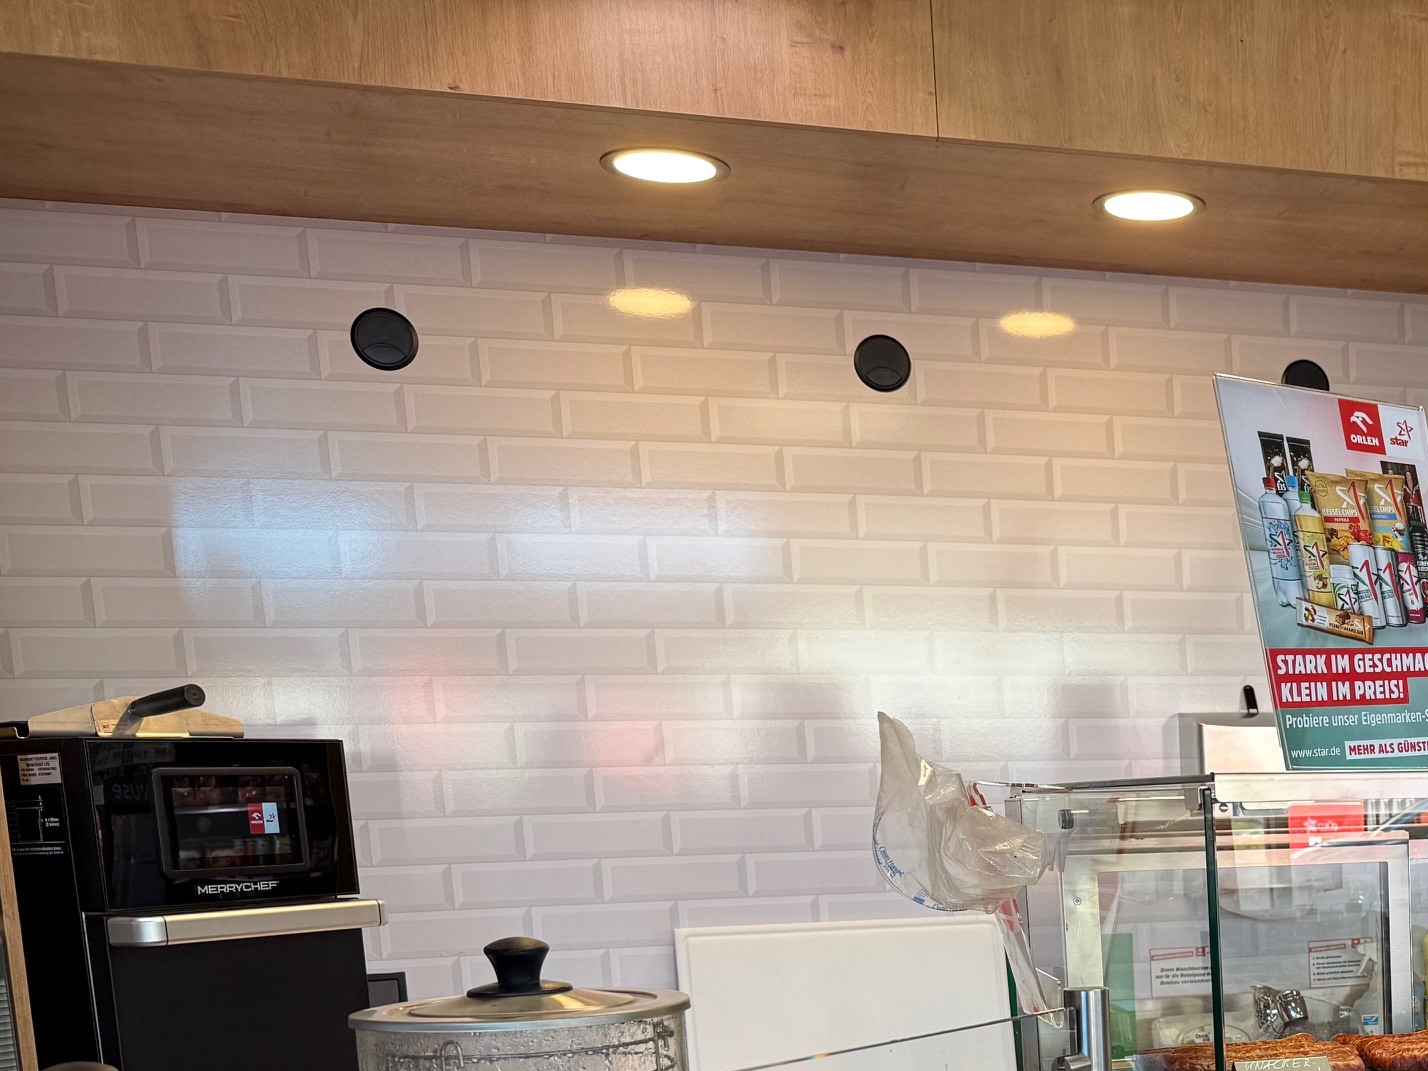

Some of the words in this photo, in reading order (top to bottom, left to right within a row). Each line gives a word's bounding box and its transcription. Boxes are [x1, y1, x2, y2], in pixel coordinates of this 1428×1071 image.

[1350, 434, 1379, 447] ORLEN
[1390, 437, 1409, 447] star
[1277, 654, 1326, 674] STARK
[1331, 654, 1349, 674] IM
[1281, 681, 1328, 702] KLEIN
[1332, 681, 1350, 700] IM
[1354, 680, 1404, 699] PREIS!
[1286, 714, 1329, 728] Probiere
[1332, 713, 1359, 726] unser
[1291, 746, 1340, 758] www.star.de
[1349, 742, 1375, 756] MEHR
[1378, 742, 1395, 754] ALS
[197, 881, 278, 895] MERRYCHEF
